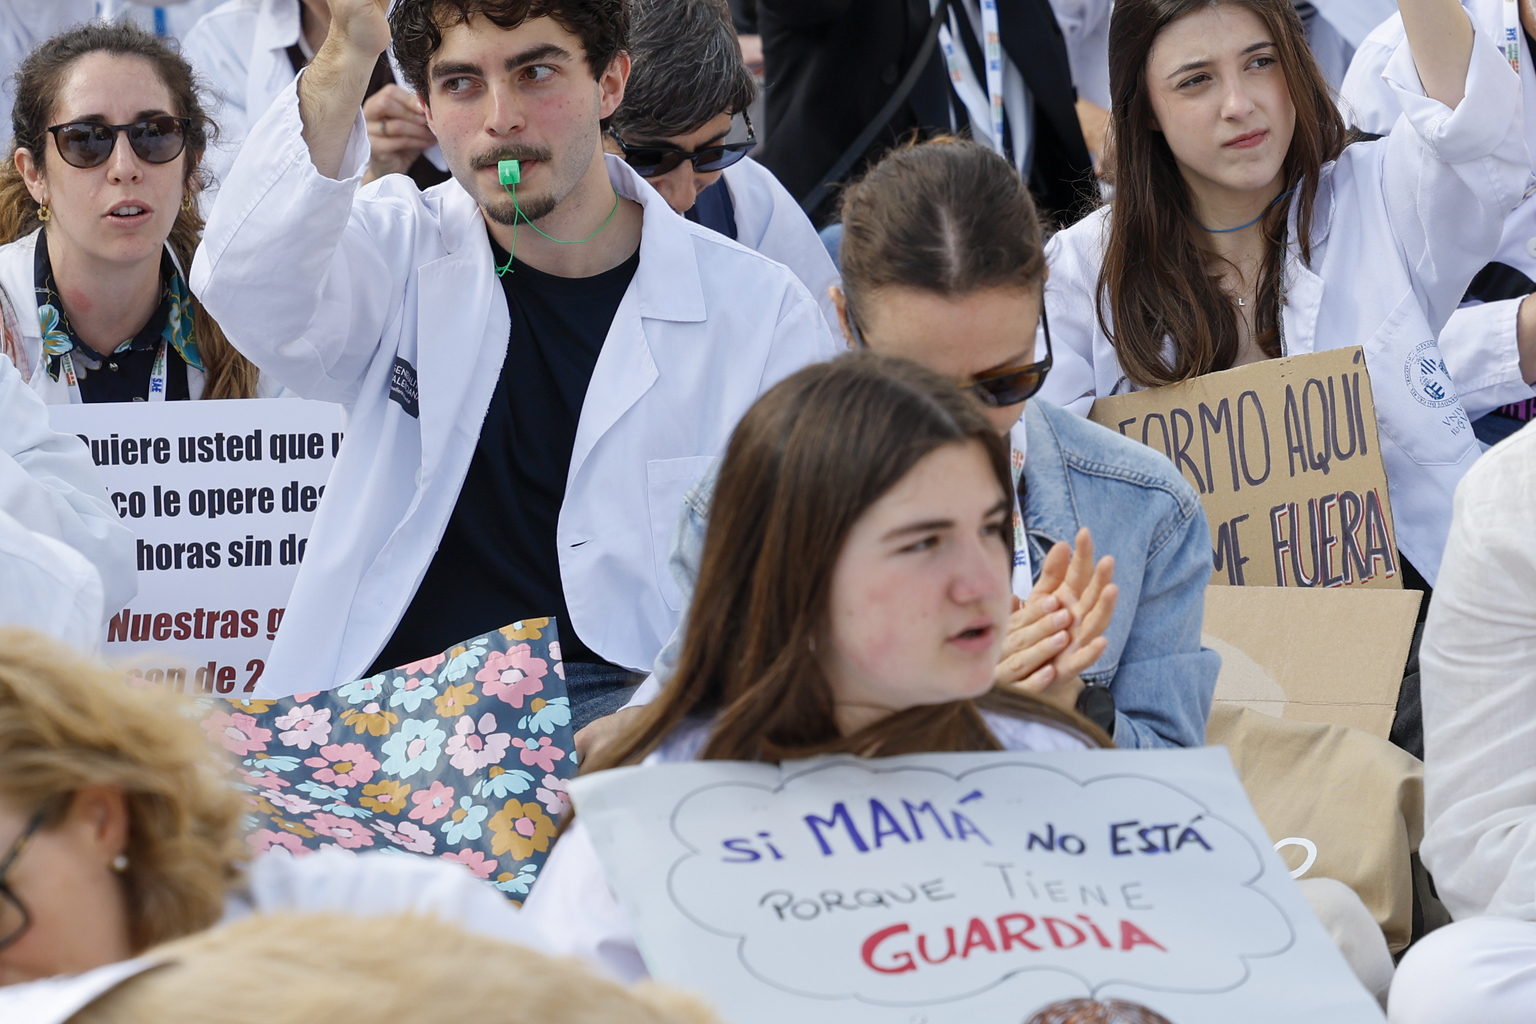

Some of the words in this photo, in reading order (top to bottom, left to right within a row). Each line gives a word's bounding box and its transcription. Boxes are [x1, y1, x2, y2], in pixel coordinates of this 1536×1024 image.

[1284, 350, 1368, 477] AQUÍ
[178, 429, 262, 464] usted
[269, 432, 324, 464] que
[153, 485, 180, 517] le
[188, 485, 274, 519] opere
[136, 538, 221, 571] horas
[228, 535, 272, 567] sin
[1270, 488, 1397, 588] FUERA
[107, 608, 259, 643] Nuestras
[193, 661, 236, 694] de
[803, 789, 993, 857] MAMÁ
[1025, 823, 1087, 855] NO
[1109, 814, 1214, 857] ESTÁ
[759, 878, 956, 923] PORQUE
[860, 912, 1169, 975] GUARDIA
